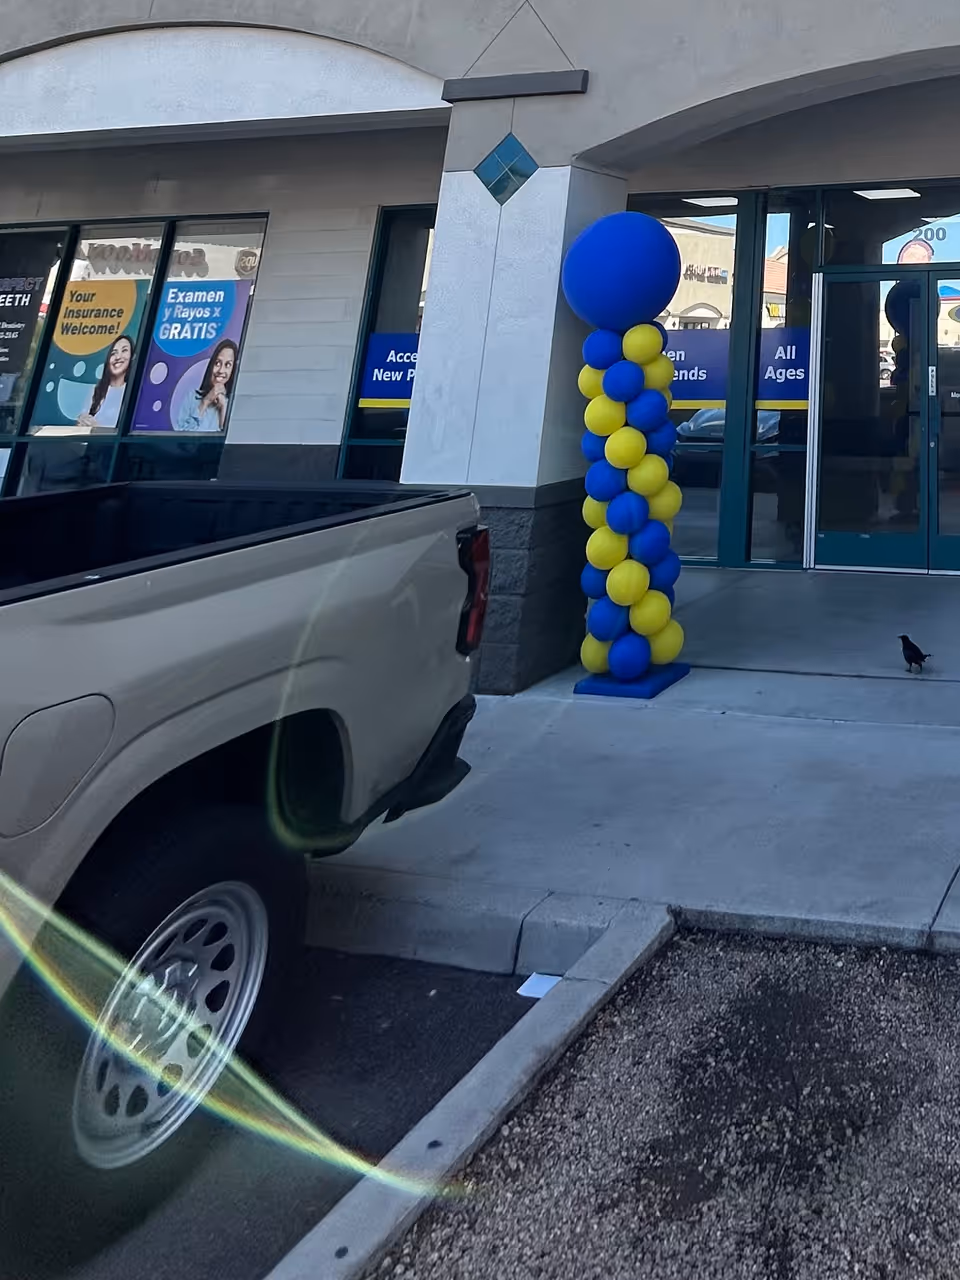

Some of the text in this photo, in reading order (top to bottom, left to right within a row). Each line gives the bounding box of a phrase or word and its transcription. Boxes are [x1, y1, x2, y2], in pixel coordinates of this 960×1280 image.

[912, 227, 947, 241] 200
[69, 290, 97, 303] Your
[167, 288, 225, 303] Examen
[63, 306, 125, 319] Insurance
[164, 305, 221, 320] y Rayos x
[60, 322, 121, 335] Welcome!
[159, 322, 218, 339] GRATIS
[387, 350, 418, 362] Acce
[774, 345, 797, 360] All
[373, 369, 403, 381] New
[673, 366, 707, 380] ends
[764, 366, 805, 382] Ages
